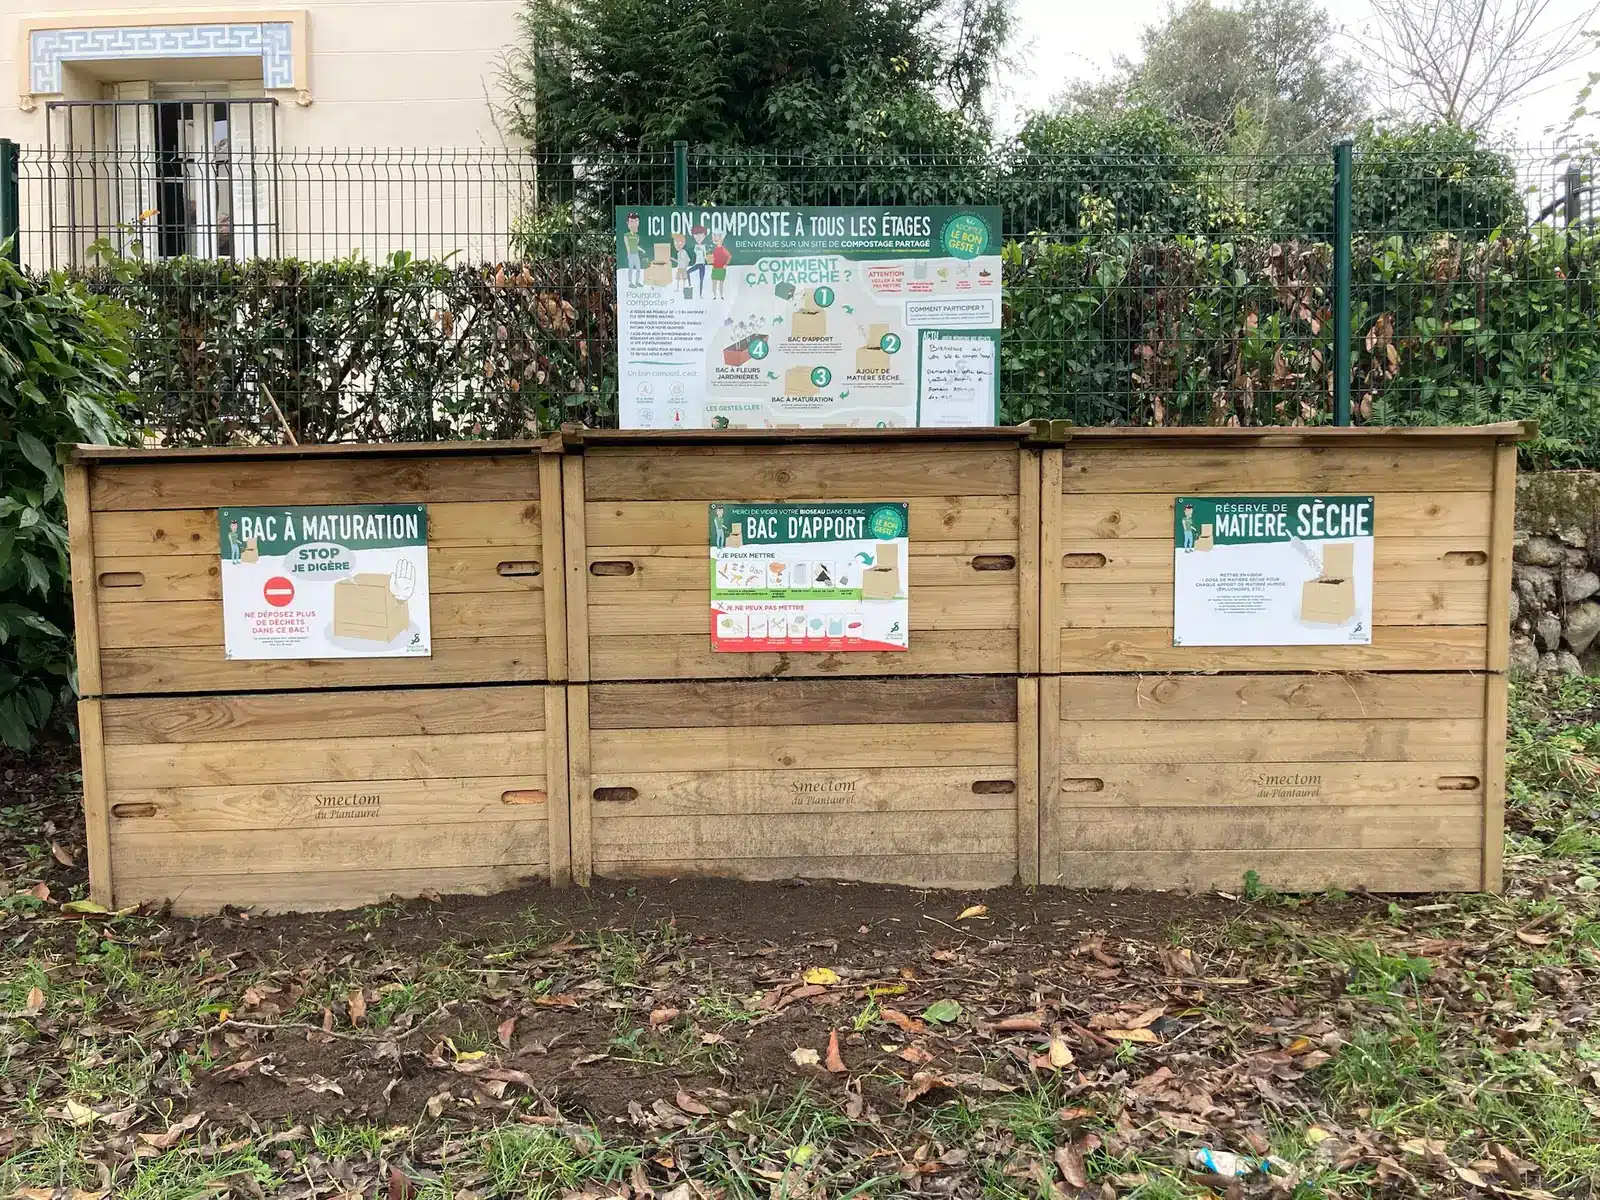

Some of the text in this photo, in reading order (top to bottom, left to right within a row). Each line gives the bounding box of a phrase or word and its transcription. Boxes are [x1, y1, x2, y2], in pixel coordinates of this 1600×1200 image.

[648, 216, 665, 236] ICI
[670, 211, 693, 237] ON
[701, 211, 790, 237] COMPOSTE
[794, 212, 805, 237] À
[809, 216, 845, 237] TOUS
[851, 216, 876, 237] LES
[882, 212, 931, 237] ÉTAGES
[735, 238, 930, 248] BIENVENUE SUR UN SITE DE COMPOSTAGE PARTAGÉ
[951, 230, 983, 244] LE BON
[949, 239, 974, 253] GESTE
[758, 258, 838, 272] COMMENT
[745, 269, 852, 288] ÇA MARCHE ?
[626, 291, 662, 300] Pourquoi
[821, 288, 827, 305] 1
[922, 330, 939, 341] ACTU
[751, 339, 765, 358] 4
[885, 335, 896, 352] 2
[637, 369, 651, 377] bon
[815, 368, 827, 385] 3
[743, 403, 760, 411] CLÉS
[1215, 503, 1288, 513] RÉSERVE DE
[1215, 498, 1370, 537] MATIERE SÈCHE
[241, 511, 419, 542] BAC À MATURATION
[747, 516, 866, 539] BAC D'APPORT
[298, 547, 340, 561] STOP
[291, 560, 350, 573] JE DIGÈRE
[244, 611, 255, 619] NE
[257, 610, 294, 618] DÉPOSEZ
[269, 618, 305, 626] DÉCHETS
[1257, 773, 1322, 786] Smectom
[791, 780, 856, 793] Smectom
[1256, 788, 1320, 798] du Plantaurel
[314, 793, 381, 807] Smectom
[791, 794, 854, 806] du Plantaurel
[314, 807, 380, 820] du Plantaurel
